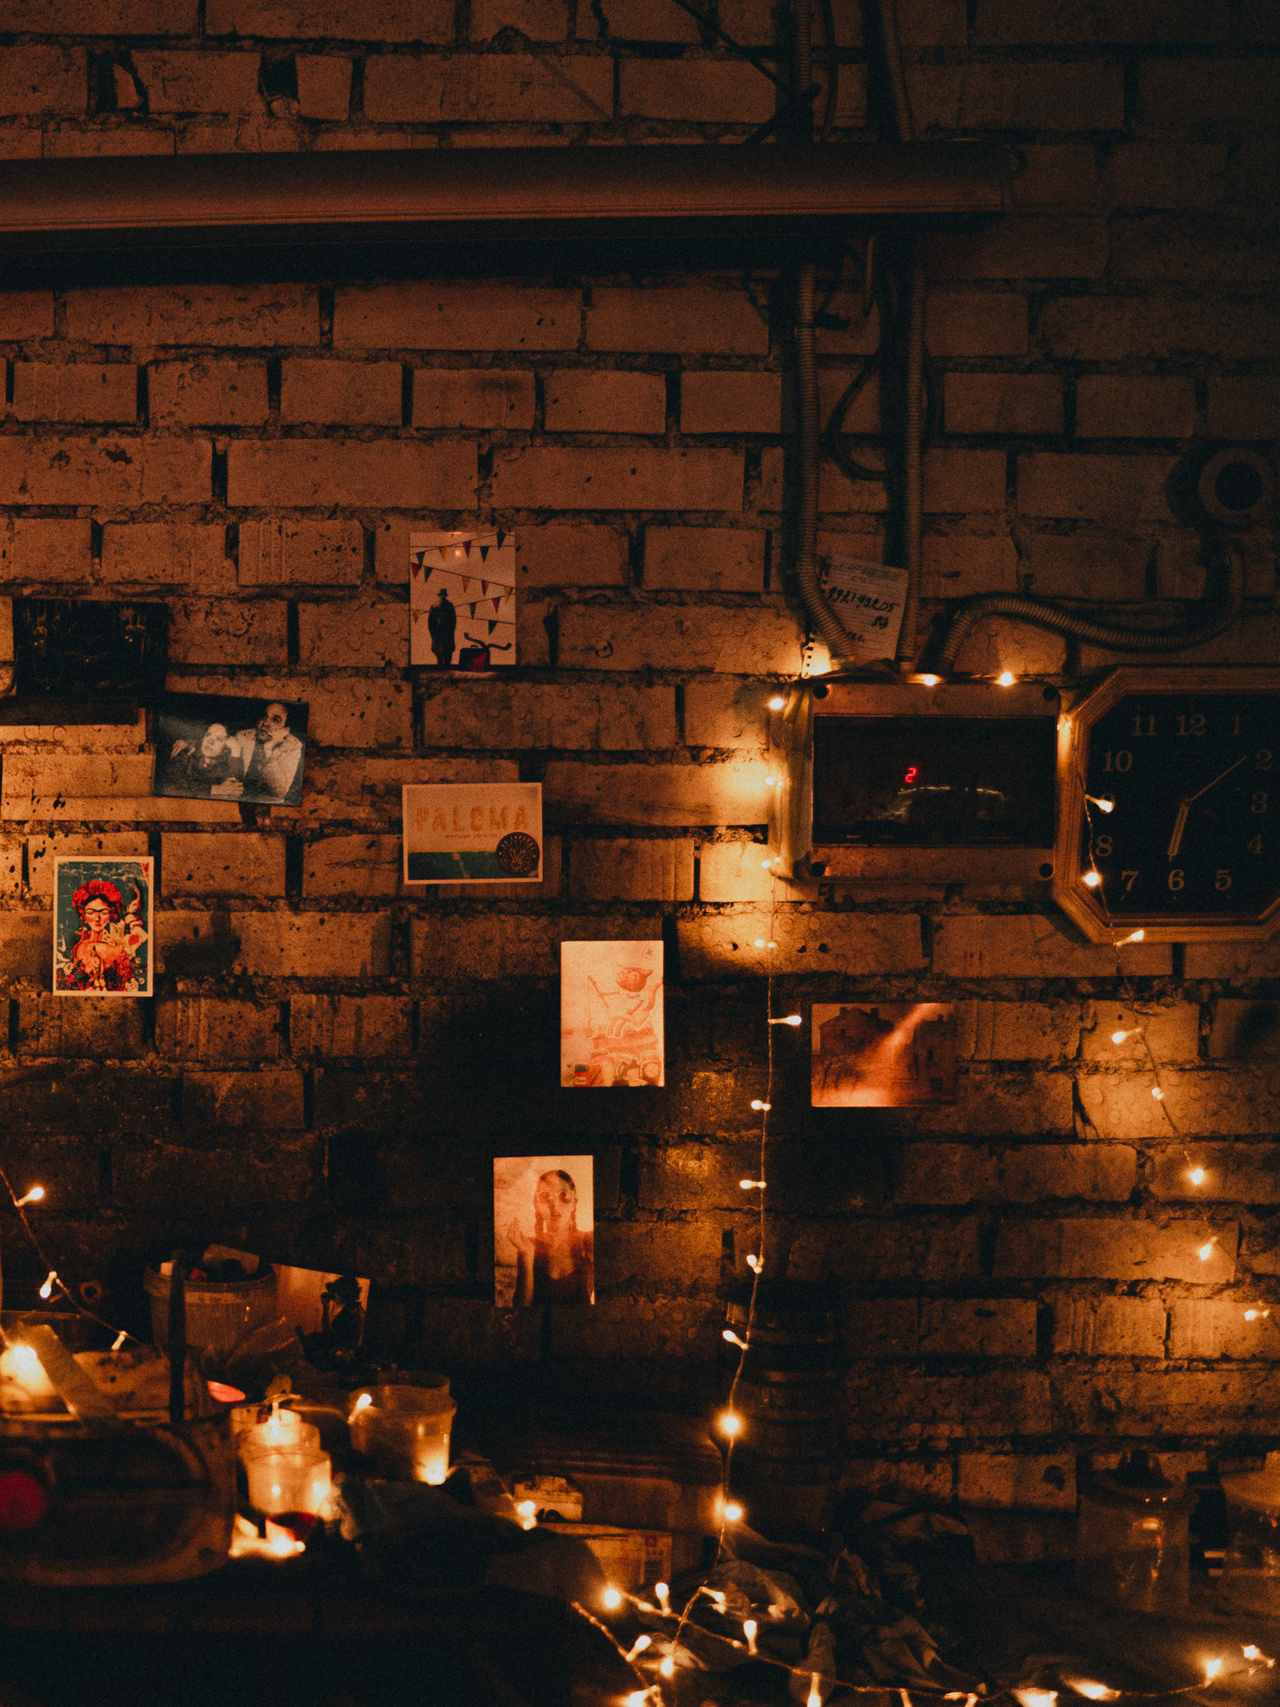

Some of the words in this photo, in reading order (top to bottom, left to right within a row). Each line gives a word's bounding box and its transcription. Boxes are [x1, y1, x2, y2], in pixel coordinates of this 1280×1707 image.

[1131, 714, 1158, 736] 11
[1175, 714, 1207, 736] 12
[1230, 714, 1242, 735] 1
[1101, 750, 1133, 772] 10
[1254, 749, 1272, 770] 2
[904, 766, 918, 783] 2
[1250, 792, 1268, 814] 3
[415, 805, 529, 832] PALOMA
[1095, 835, 1113, 857] 8
[1247, 833, 1264, 855] 4
[1121, 869, 1139, 891] 7
[1167, 869, 1185, 891] 6
[1214, 869, 1232, 891] 5
